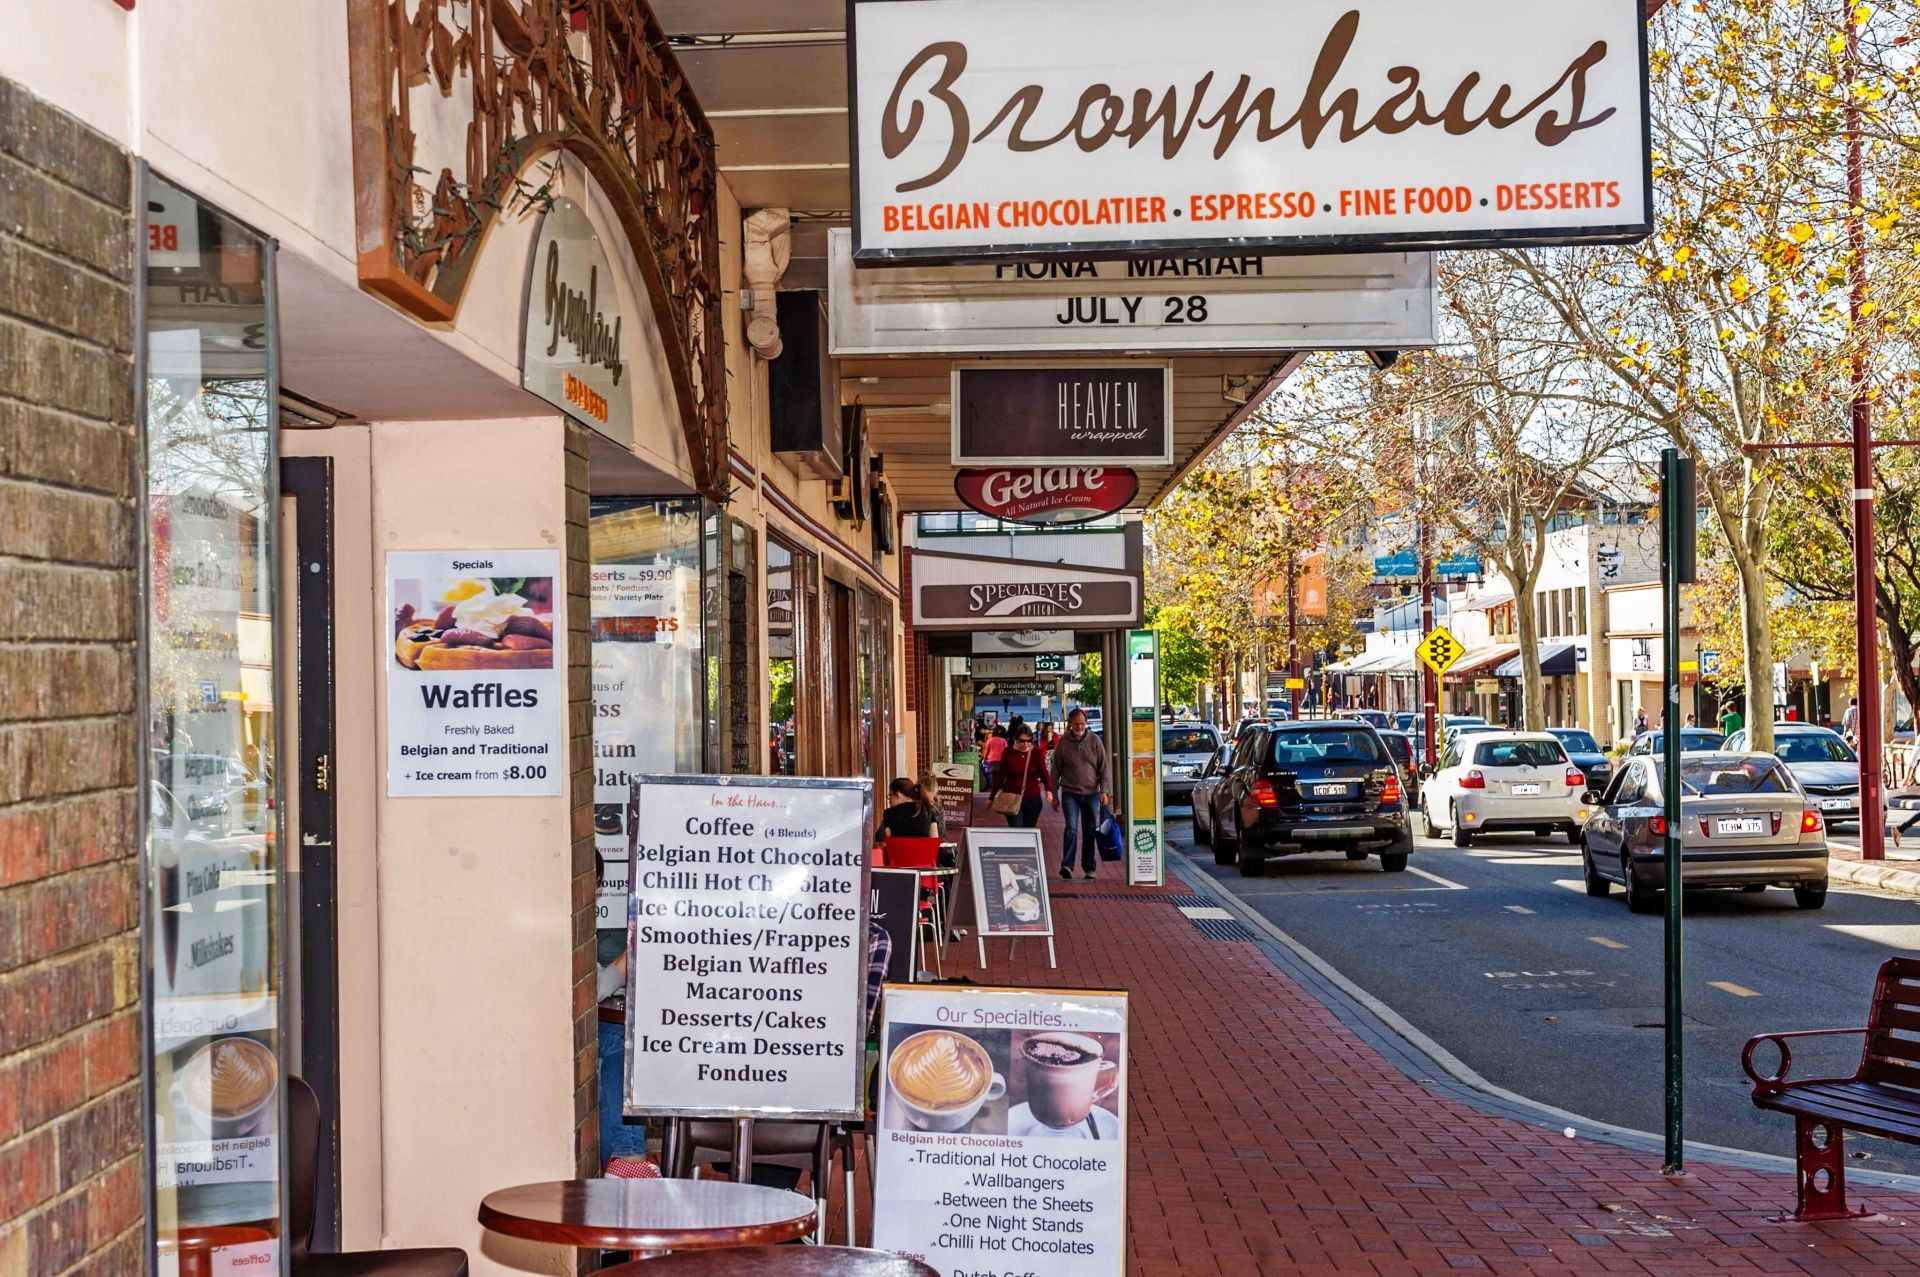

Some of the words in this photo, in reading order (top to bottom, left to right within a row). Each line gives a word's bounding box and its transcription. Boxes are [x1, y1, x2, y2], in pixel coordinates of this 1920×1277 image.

[881, 9, 1617, 193] Brownhaus
[883, 202, 990, 232] BELGIAN
[997, 196, 1167, 228] CHOCOLATIER
[1190, 191, 1316, 221] ESPRESSO
[1339, 188, 1397, 217] FINE
[1404, 186, 1472, 214] FOOD
[1496, 181, 1621, 211] DESSERTS
[995, 261, 1098, 279] FIONA
[1127, 256, 1264, 277] MARIAH
[1056, 296, 1143, 324] JULY
[1164, 295, 1208, 323] 28
[1058, 382, 1138, 430] HEAVEN
[1070, 428, 1148, 442] wrapped
[1005, 506, 1016, 518] All
[1017, 499, 1049, 513] Natural
[1051, 496, 1063, 505] Ice
[1064, 493, 1092, 504] Cream
[452, 560, 494, 571] Specials
[639, 569, 672, 582] $9.90
[614, 593, 642, 602] Variety
[644, 593, 665, 601] Plate
[969, 583, 1083, 611] SPECIALEYES
[420, 683, 538, 709] Waffles
[612, 681, 625, 692] of
[444, 725, 480, 737] Freshly
[483, 724, 514, 736] Baked
[400, 745, 448, 758] Belgian
[452, 744, 475, 756] and
[479, 743, 548, 756] Traditional
[416, 771, 434, 781] Ice
[437, 773, 472, 781] cream
[475, 769, 499, 780] from
[502, 765, 547, 780] $8.00
[711, 793, 719, 806] In
[727, 793, 743, 807] the
[685, 817, 755, 837] Coffee
[764, 828, 775, 839] (4
[778, 828, 817, 839] Blends)
[717, 846, 755, 864] Hot
[761, 847, 863, 867] Chocolate
[643, 871, 698, 890] Chilli
[704, 873, 743, 891] Hot
[748, 874, 852, 893] Cholate
[638, 899, 668, 916] Ice
[674, 899, 856, 924] Chocolate/Coffee
[641, 926, 851, 951] Smoothies/Frappes
[190, 932, 234, 969] Milkshakes
[663, 954, 743, 977] Belgian
[748, 956, 828, 975] Waffles
[686, 982, 803, 1001] Macaroons
[661, 1008, 827, 1033] Desserts/Cakes
[936, 1006, 967, 1024] Our
[973, 1008, 1079, 1028] Specialties...
[642, 1035, 672, 1053] Ice
[678, 1036, 747, 1055] Cream
[753, 1038, 844, 1057] Desserts
[697, 1064, 788, 1082] Fondues
[891, 1132, 934, 1146] Belgian
[937, 1135, 958, 1147] Hot
[961, 1136, 1024, 1149] Chocolates
[916, 1150, 995, 1167] Traditional
[1001, 1152, 1028, 1169] Hot
[1033, 1154, 1107, 1172] Chocolate
[972, 1173, 1065, 1192] Wallbangers
[942, 1193, 1007, 1209] Between
[1013, 1194, 1037, 1210] the
[1043, 1196, 1094, 1213] Sheets
[950, 1213, 981, 1229] One
[987, 1214, 1027, 1233] Night
[1032, 1216, 1084, 1233] Stands
[938, 1233, 974, 1249] Chilli
[980, 1235, 1007, 1250] Hot
[1012, 1236, 1094, 1255] Chocolates
